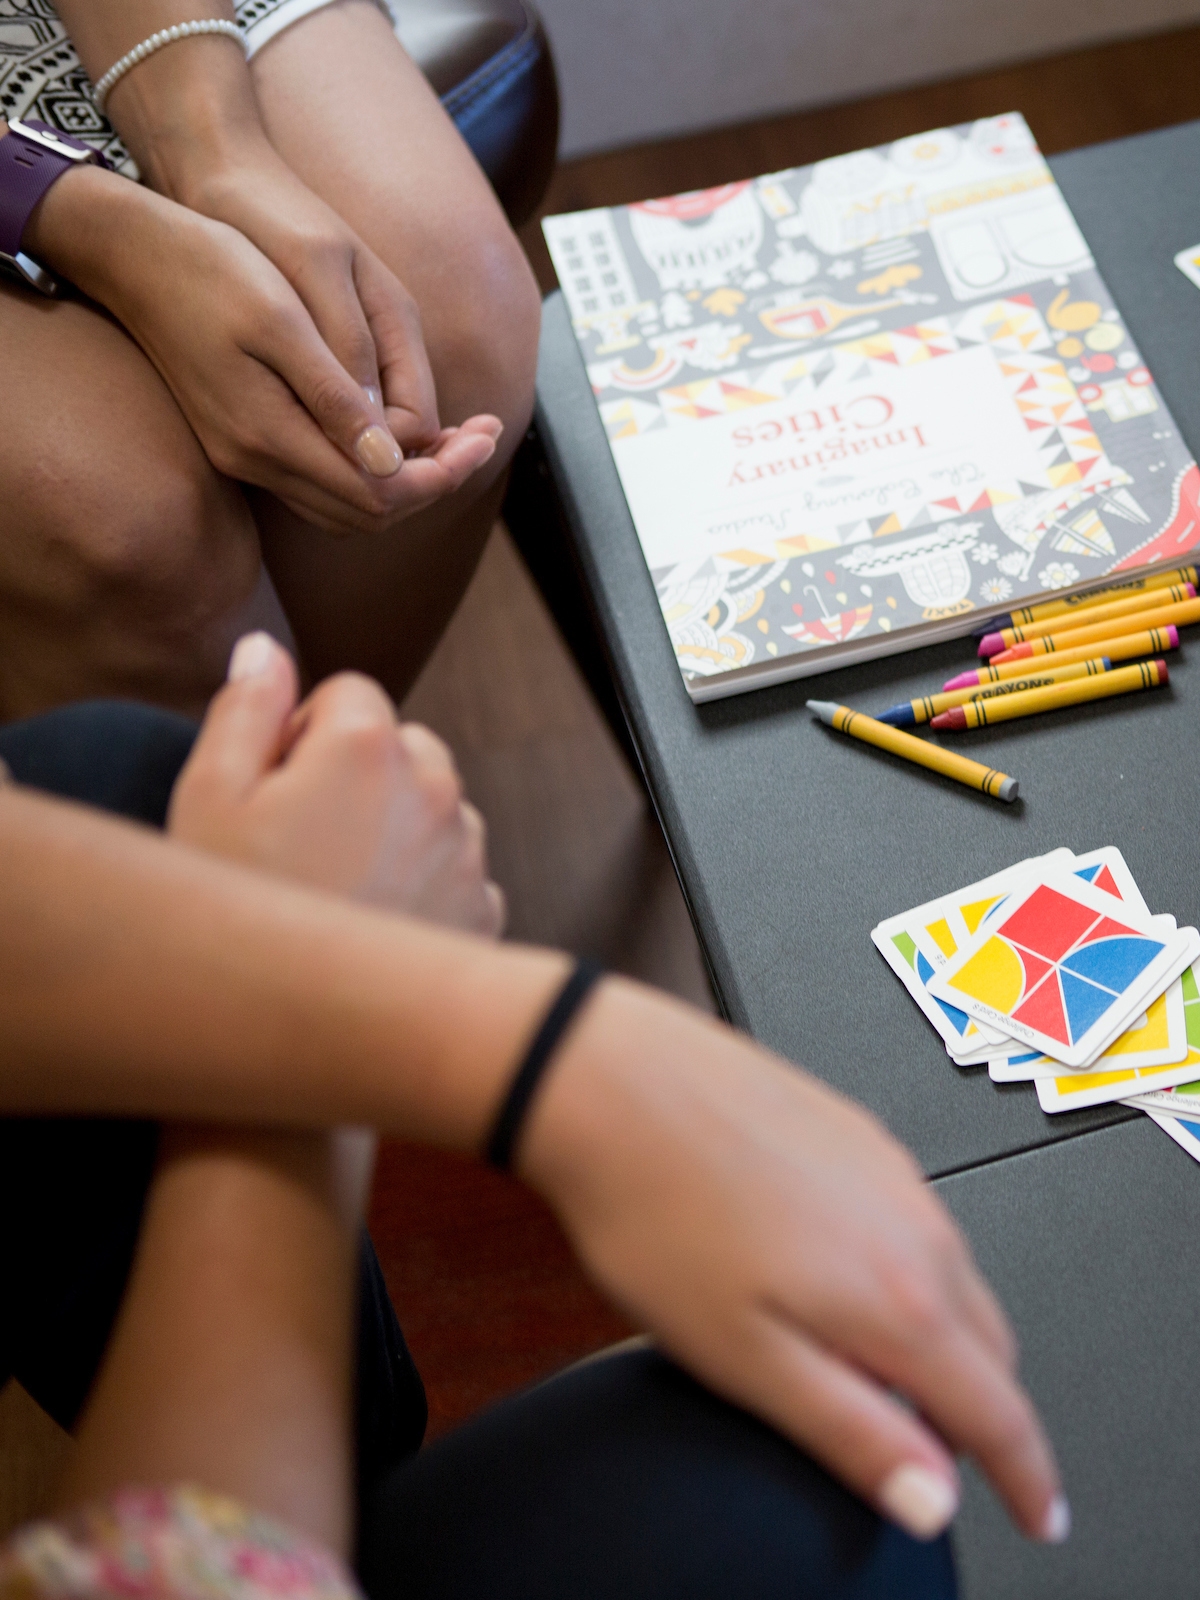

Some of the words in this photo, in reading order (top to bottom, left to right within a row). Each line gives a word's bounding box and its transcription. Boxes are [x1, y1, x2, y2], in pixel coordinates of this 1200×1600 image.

[731, 394, 894, 449] Cities
[727, 423, 931, 487] Imaginary
[929, 461, 986, 486] The
[803, 477, 922, 511] Coloring
[707, 508, 791, 535] Studio
[927, 603, 970, 616] TAXI
[979, 1006, 998, 1020] Card
[998, 1016, 1035, 1039] Challenge
